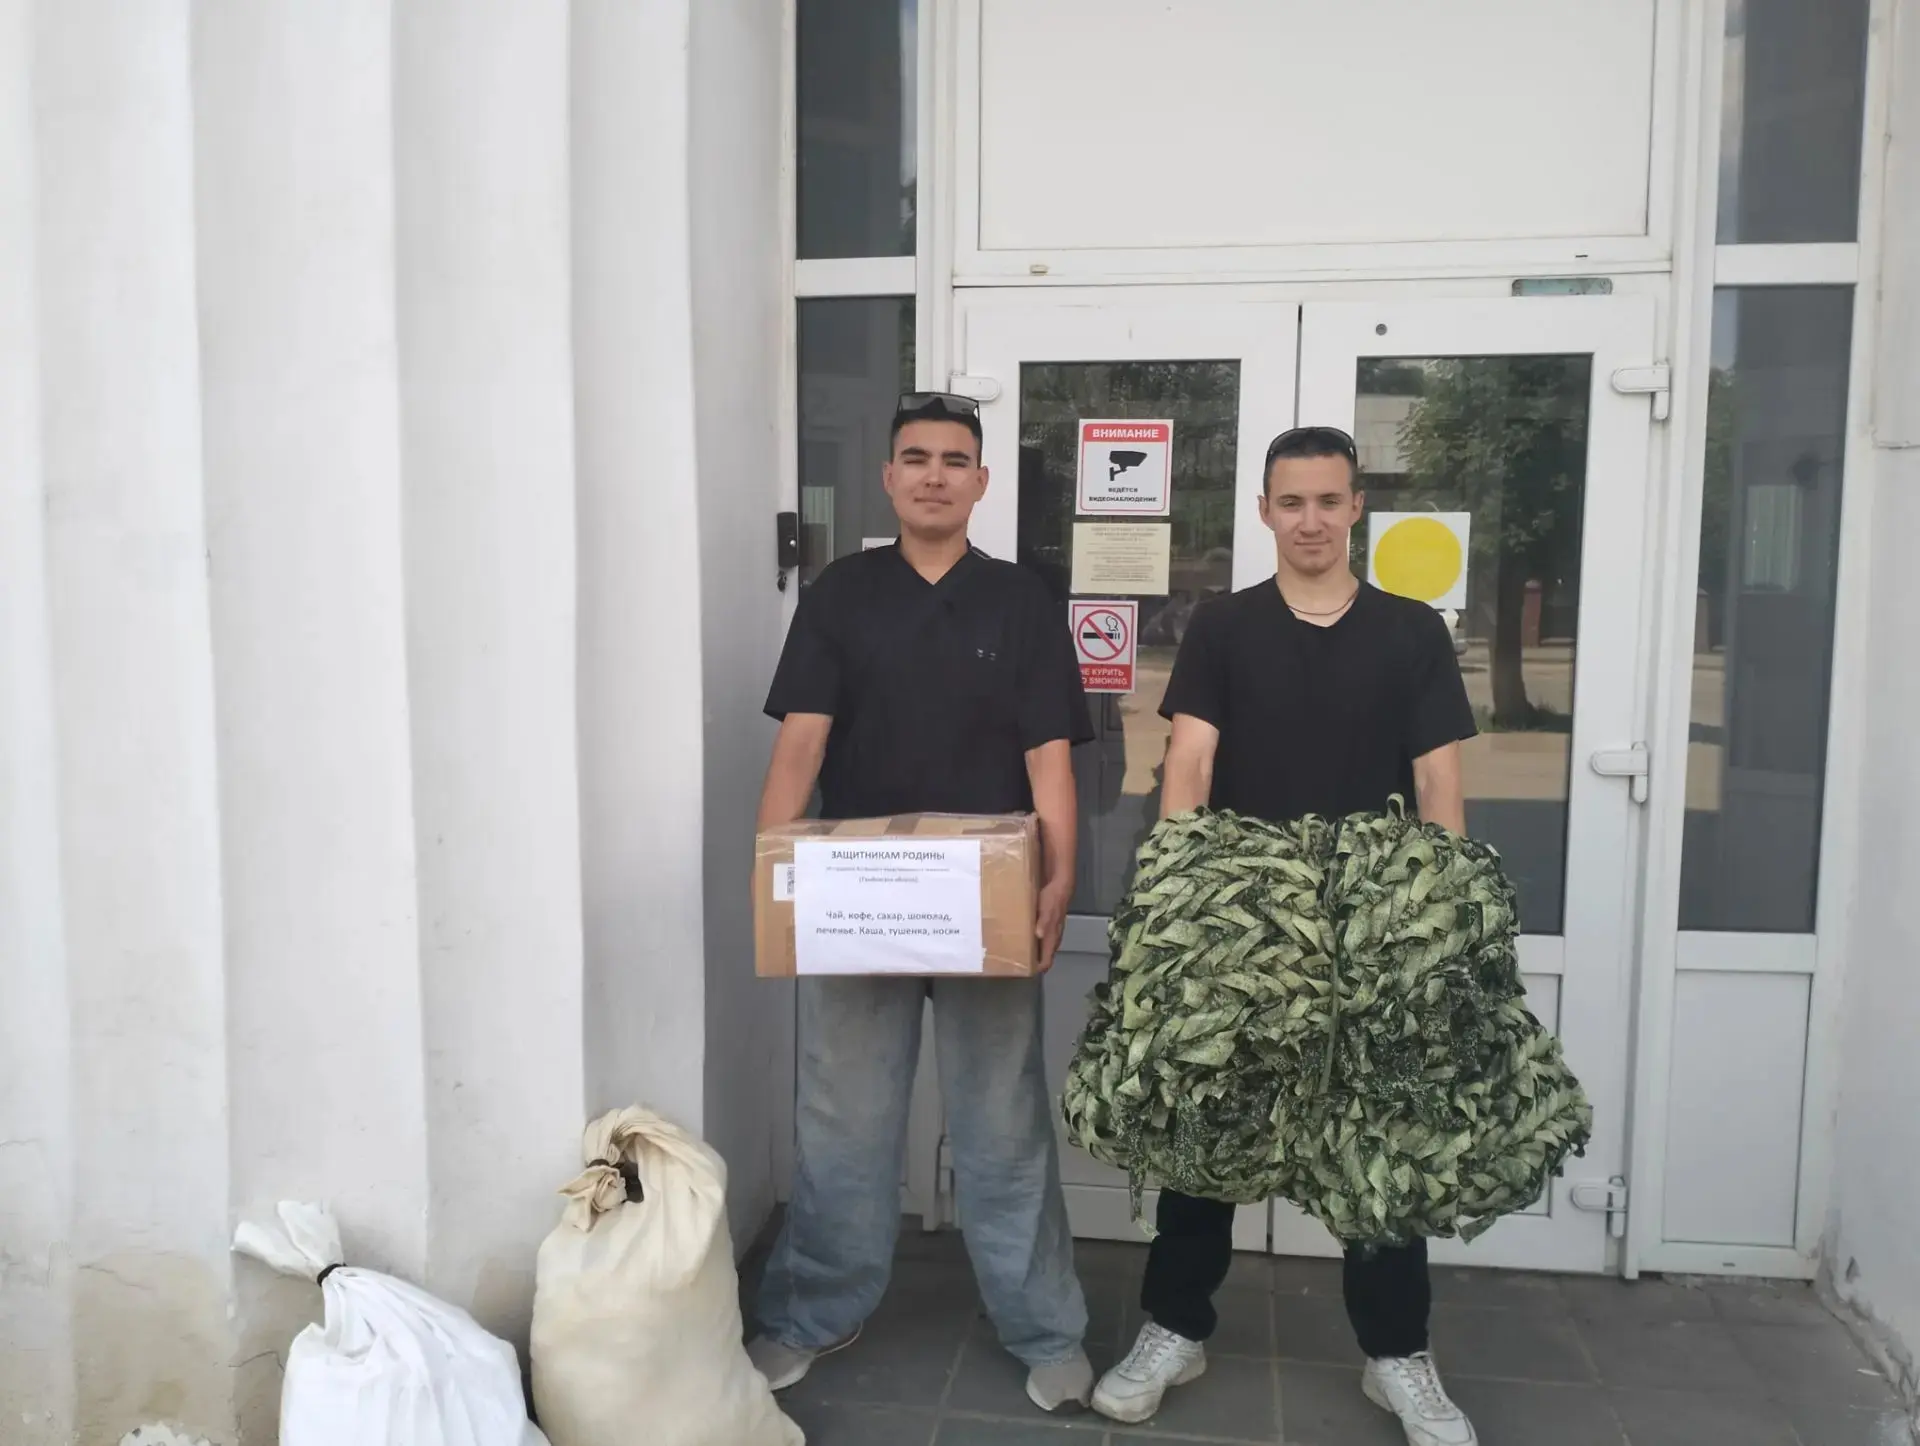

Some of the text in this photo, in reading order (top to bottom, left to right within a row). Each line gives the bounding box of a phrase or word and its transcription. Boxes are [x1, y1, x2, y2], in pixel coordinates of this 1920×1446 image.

[1092, 428, 1160, 438] ВНИМАНИЕ
[1091, 668, 1124, 676] КУРИТЬ
[1089, 677, 1128, 685] SMOKING
[831, 850, 945, 861] ЗАЩИТНИКАМ РОДИНЫ
[825, 909, 952, 922] Чай, кофе, сахар, шоколад,
[816, 927, 857, 935] печенье.
[859, 926, 886, 936] Каша,
[888, 928, 930, 936] тушенка,
